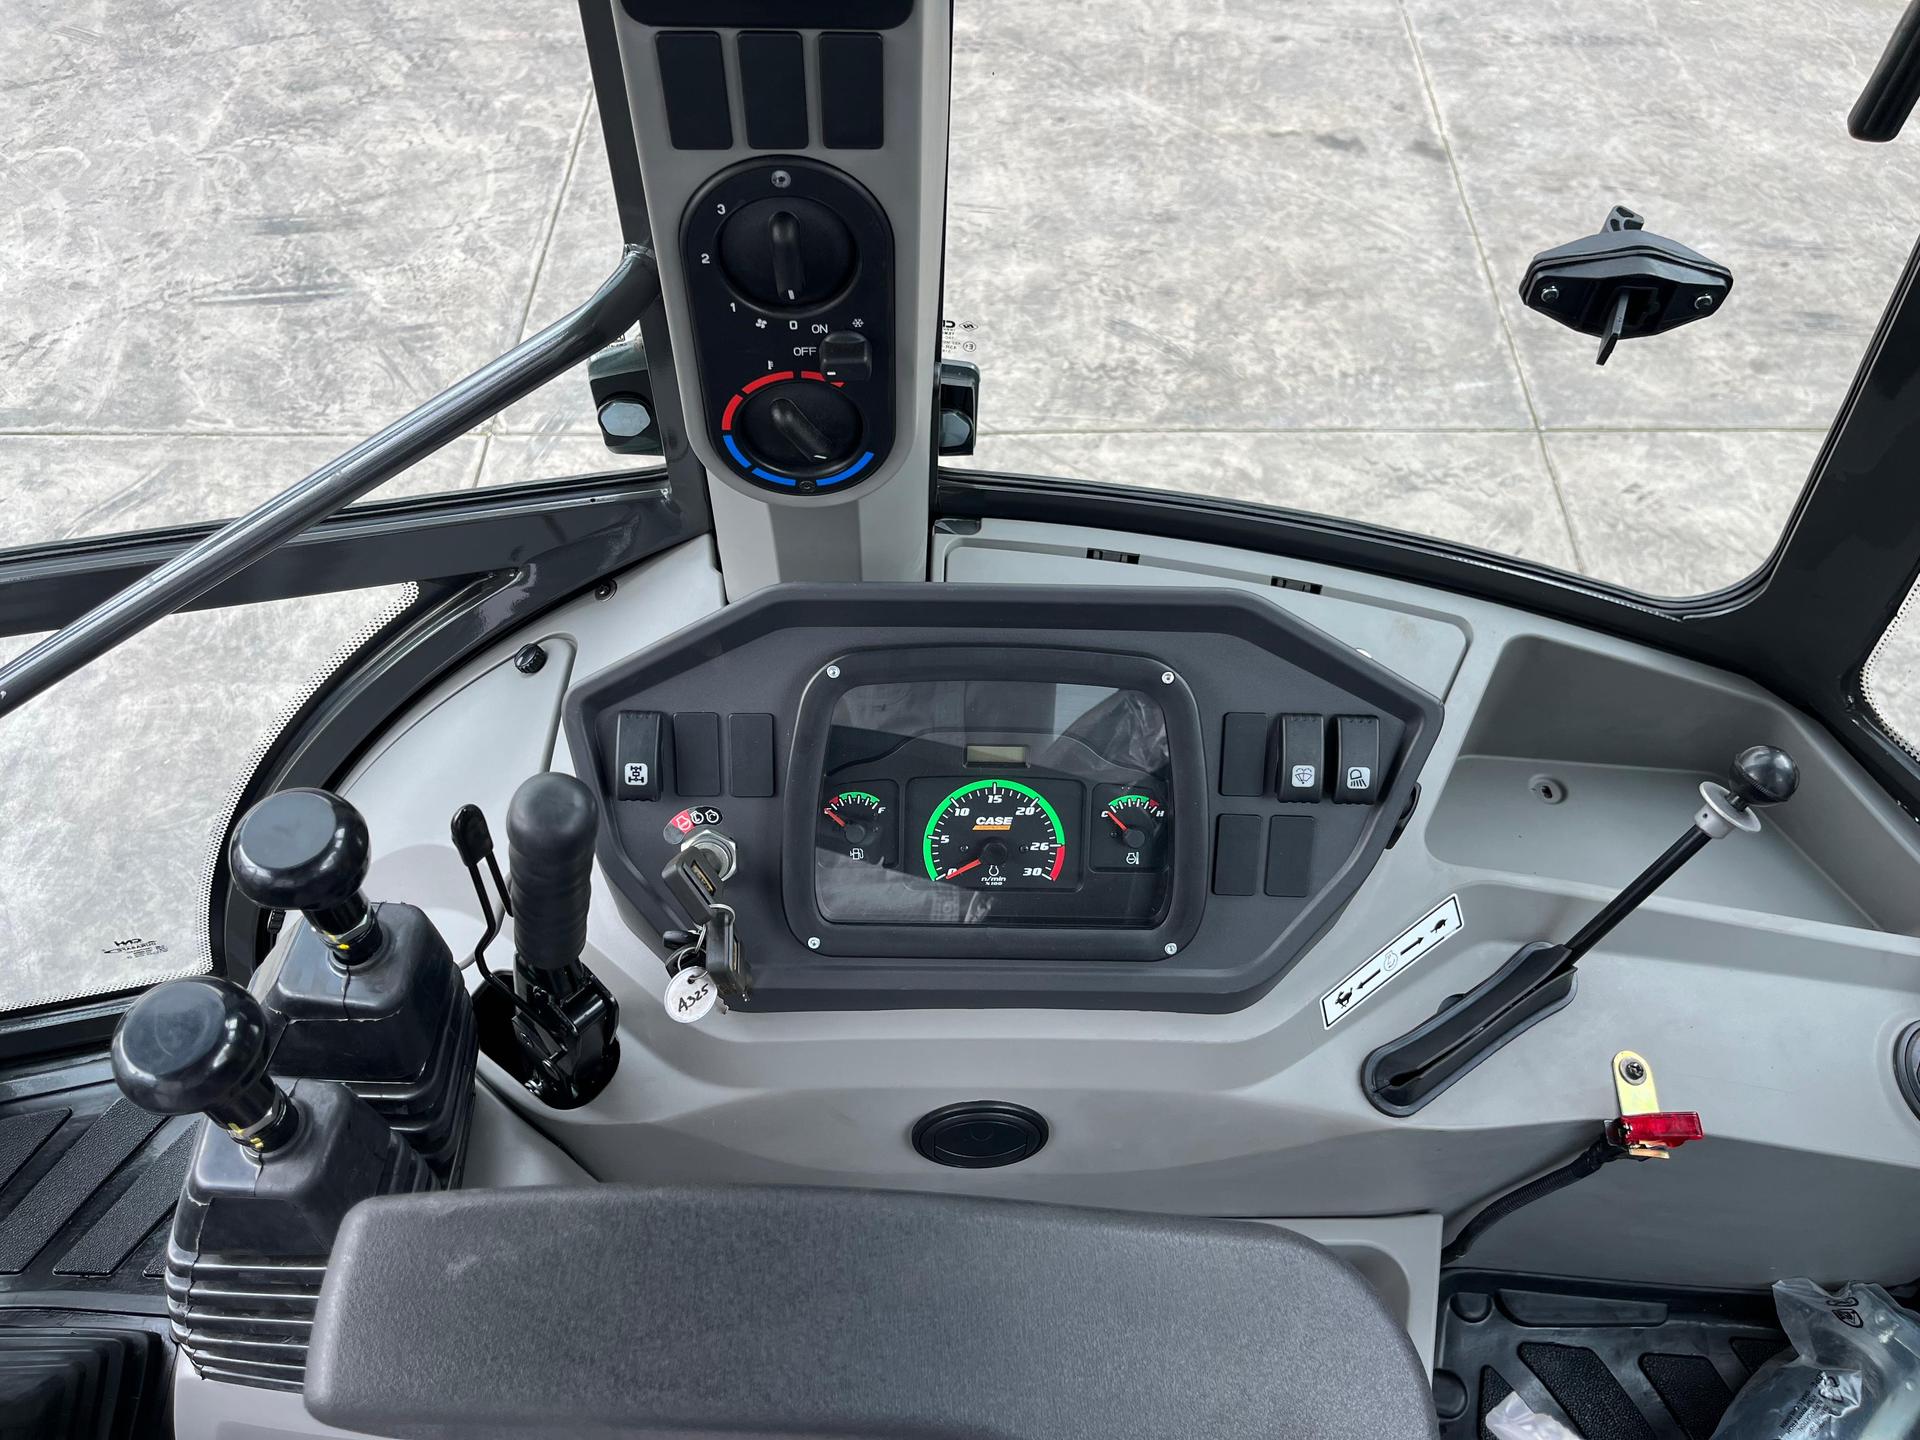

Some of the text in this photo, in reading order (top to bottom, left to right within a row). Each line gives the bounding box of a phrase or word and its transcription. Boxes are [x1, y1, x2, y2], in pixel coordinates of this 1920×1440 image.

[717, 203, 726, 215] 3
[701, 253, 710, 264] 2
[730, 302, 736, 313] 1
[811, 324, 829, 334] ON
[793, 347, 817, 357] OFF
[987, 794, 1003, 804] 15
[877, 806, 887, 814] F
[954, 807, 970, 817] 10
[1015, 806, 1036, 816] 20
[975, 816, 1014, 825] CASE
[940, 834, 950, 844] 5
[1030, 842, 1050, 851] 26
[1022, 867, 1043, 877] 30
[678, 982, 709, 1012] A325
